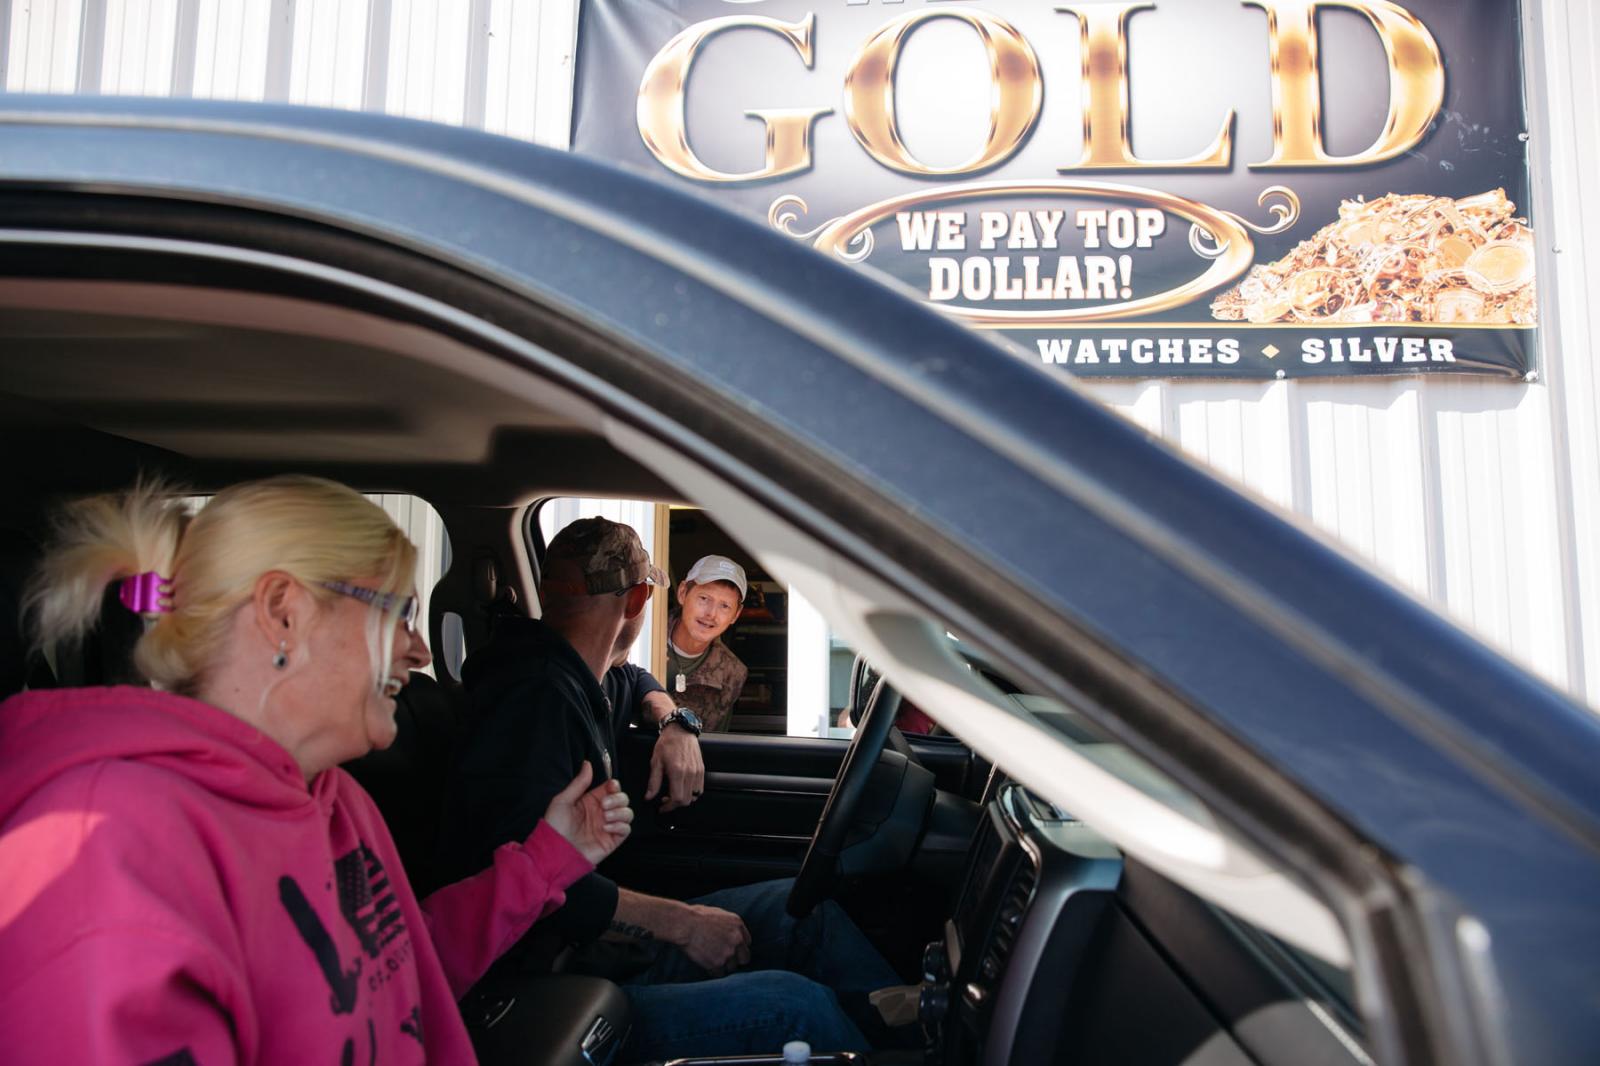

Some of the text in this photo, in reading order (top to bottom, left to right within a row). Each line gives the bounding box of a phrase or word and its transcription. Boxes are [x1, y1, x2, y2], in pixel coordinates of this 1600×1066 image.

[637, 0, 1447, 182] GOLD
[897, 209, 1167, 251] WE PAY TOP
[928, 255, 1134, 301] DOLLAR!
[1037, 337, 1457, 364] WATCHES SILVER
